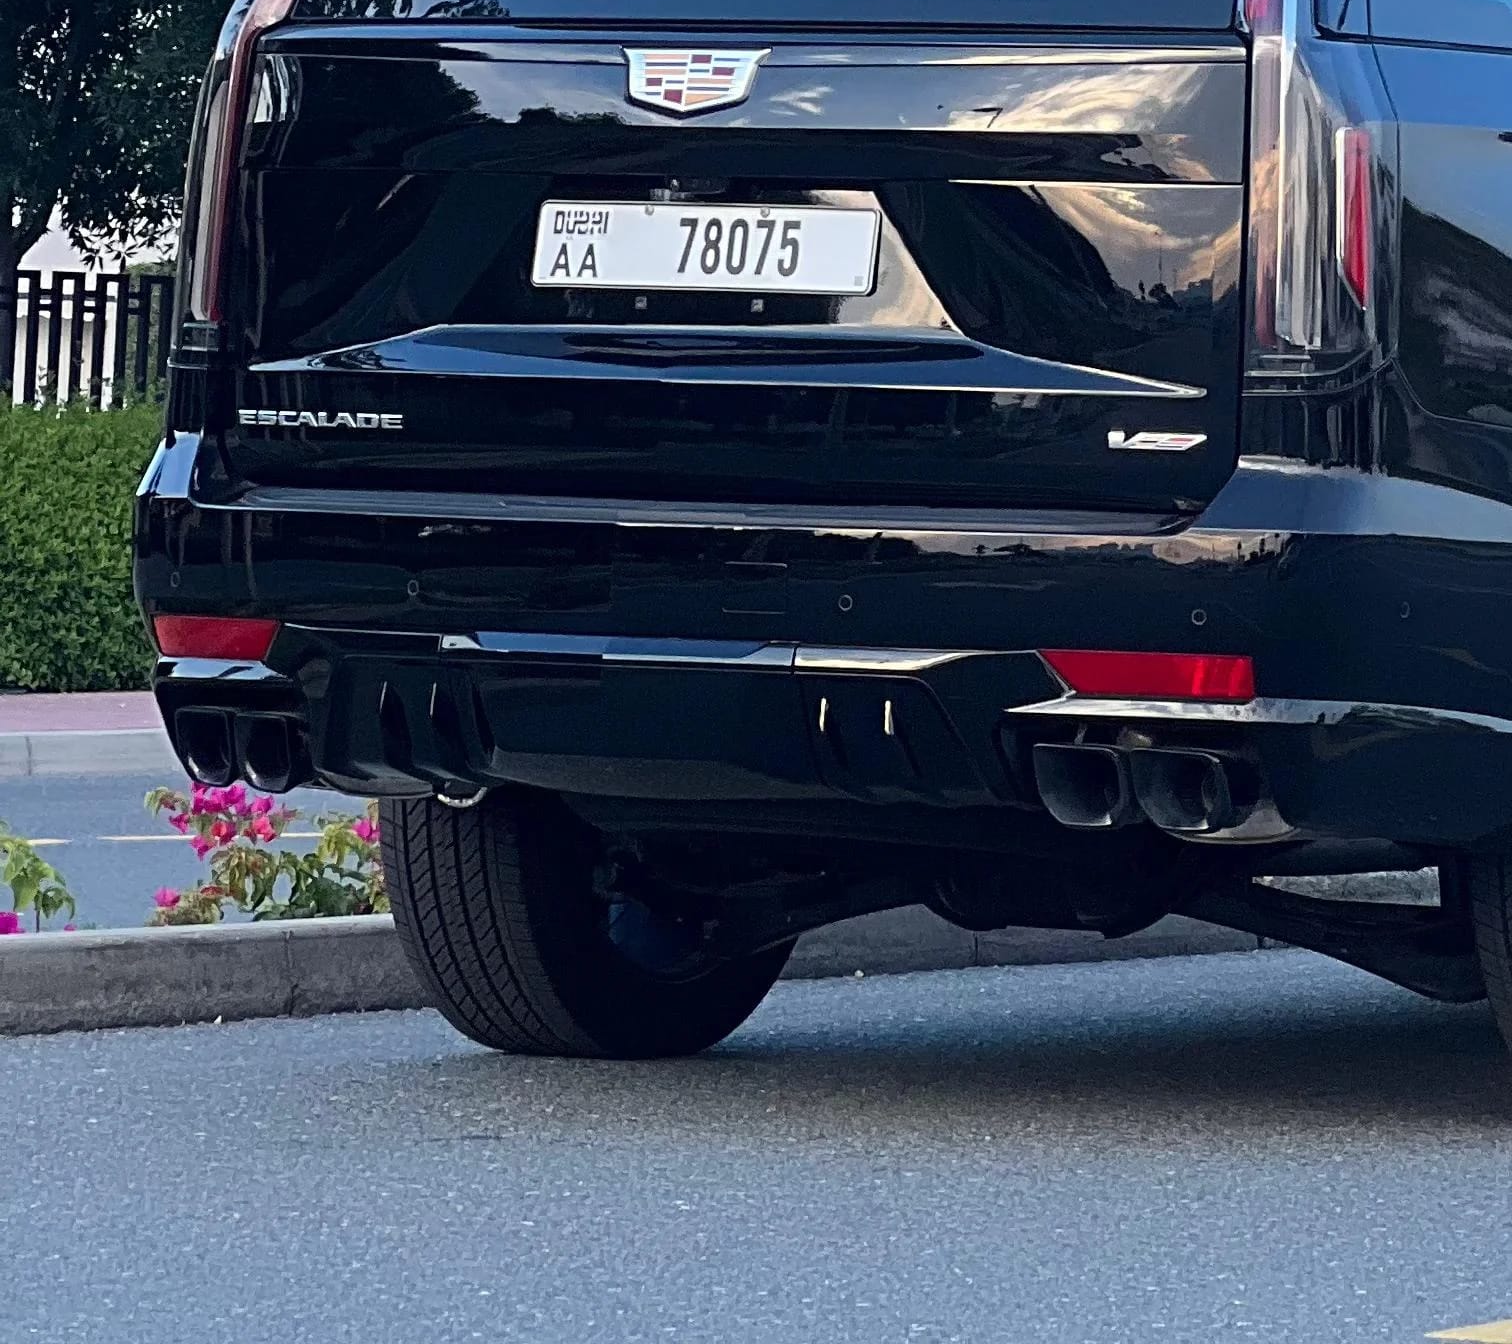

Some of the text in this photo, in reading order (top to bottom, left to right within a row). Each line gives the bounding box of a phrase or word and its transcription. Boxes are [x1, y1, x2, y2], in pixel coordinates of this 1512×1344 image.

[550, 217, 801, 278] AA 78075
[238, 409, 403, 429] ESCALADE
